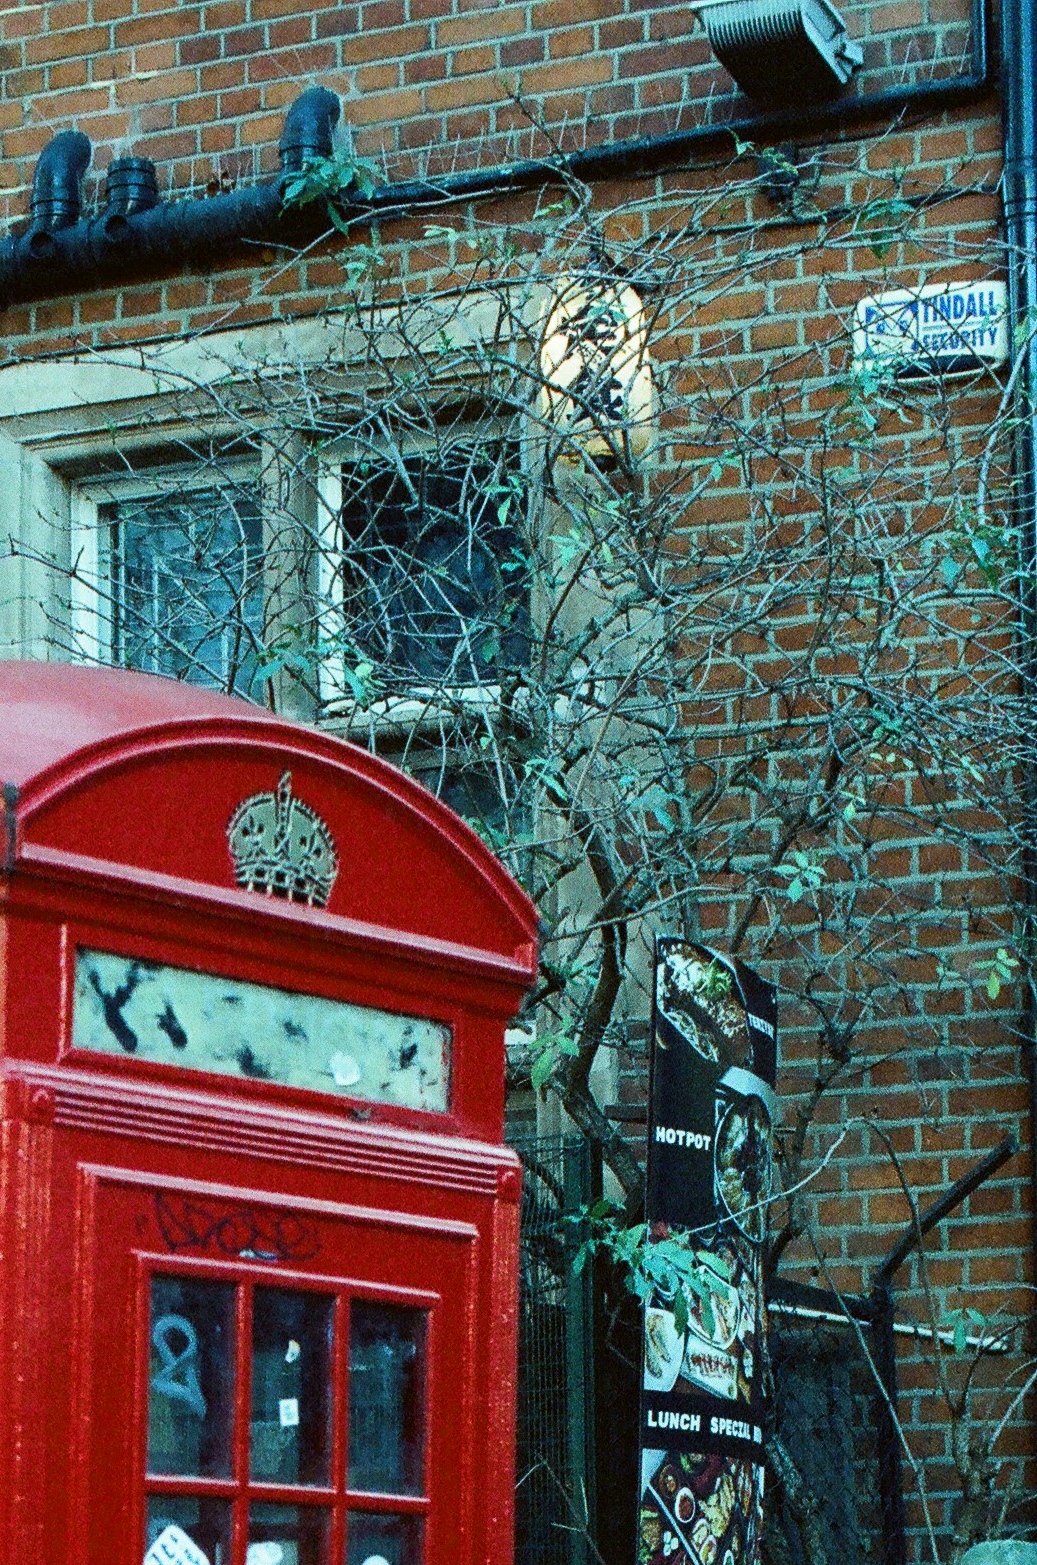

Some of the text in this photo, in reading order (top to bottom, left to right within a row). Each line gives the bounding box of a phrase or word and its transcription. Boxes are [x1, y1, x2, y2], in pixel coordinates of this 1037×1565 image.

[922, 290, 998, 323] TINDALL
[655, 1125, 712, 1151] HOTPOT
[647, 1409, 701, 1432] LUNCH
